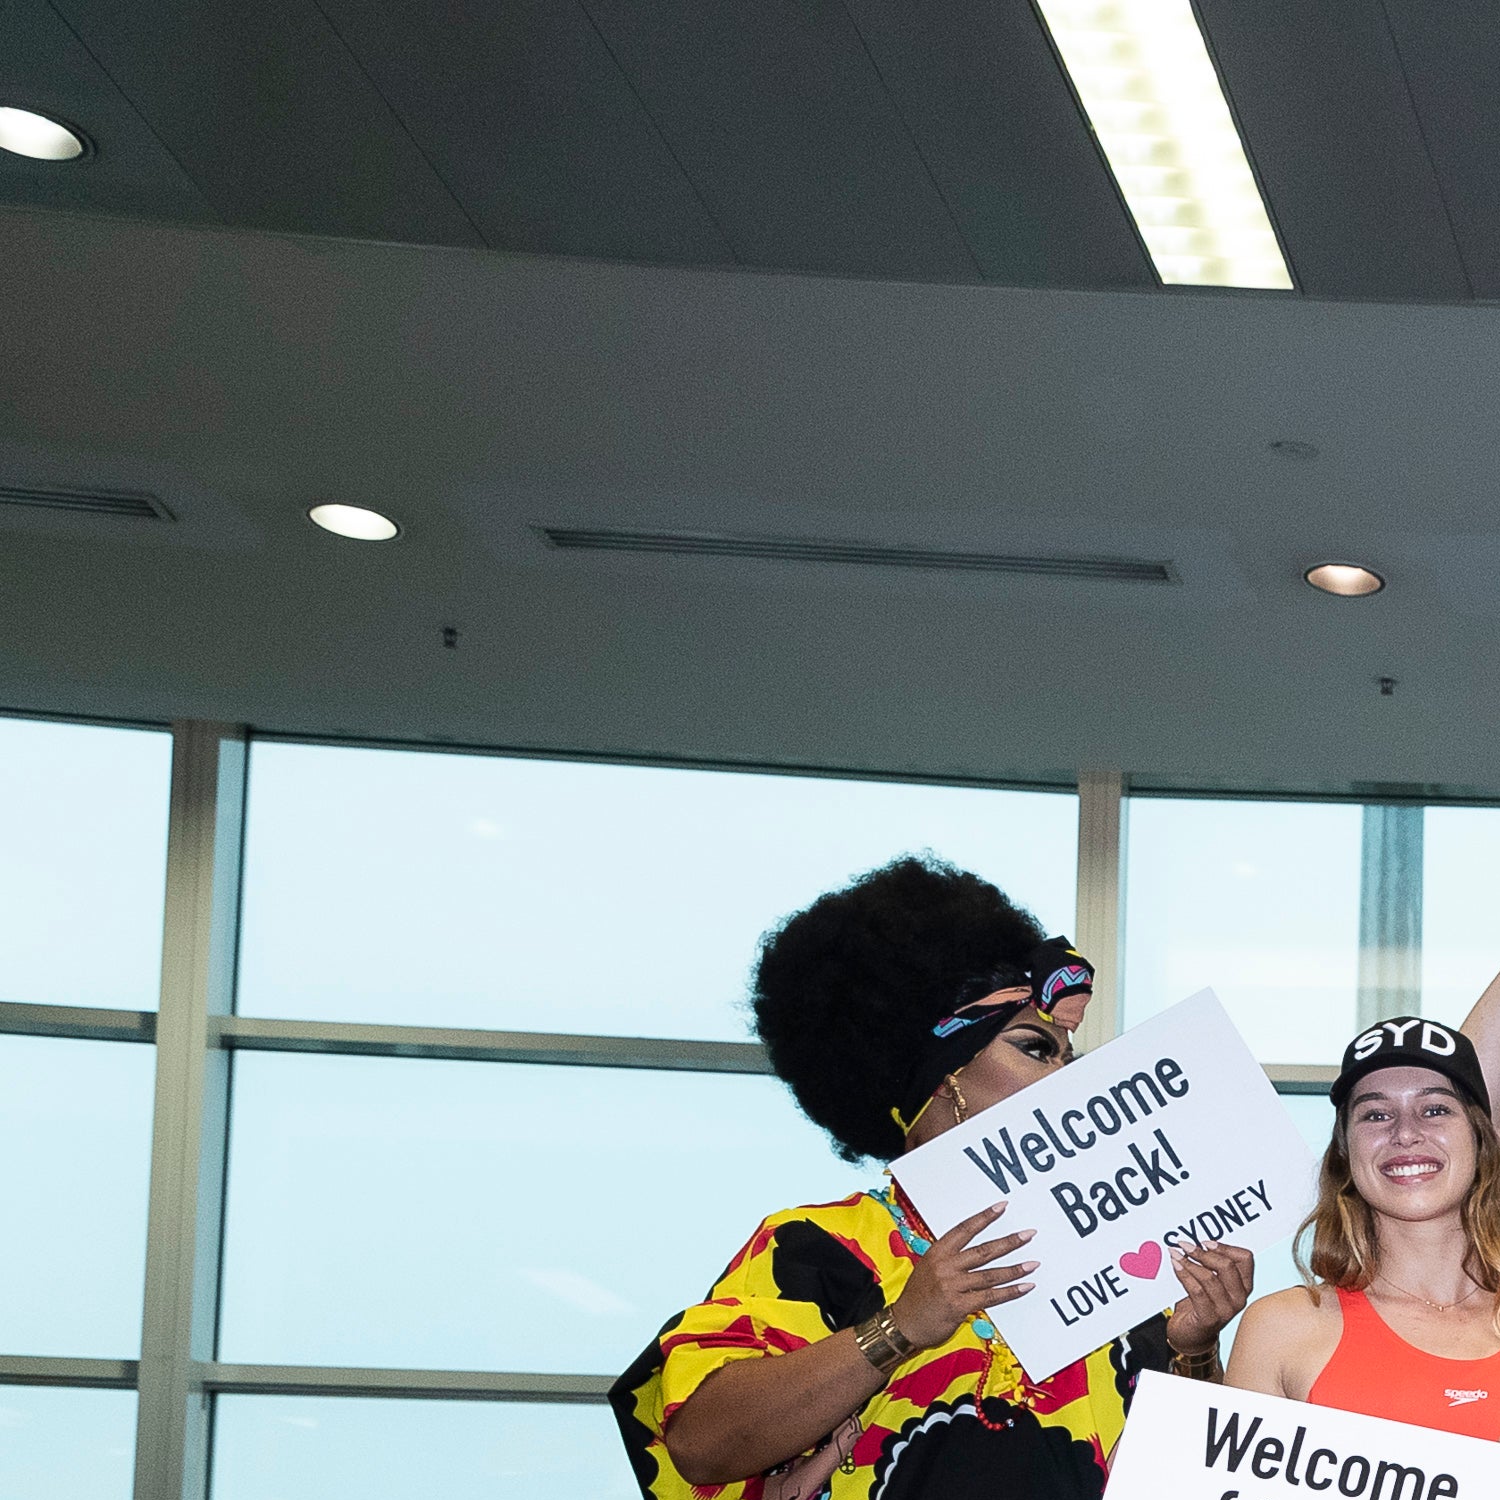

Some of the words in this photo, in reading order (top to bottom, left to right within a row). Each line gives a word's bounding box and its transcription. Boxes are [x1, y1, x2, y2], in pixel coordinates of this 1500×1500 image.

[1354, 1020, 1456, 1060] SYD
[963, 1058, 1189, 1195] Welcome
[1050, 1129, 1190, 1239] Back!
[1050, 1265, 1128, 1327] LOVE
[1163, 1179, 1273, 1250] SYDNEY
[1444, 1388, 1488, 1400] speedo
